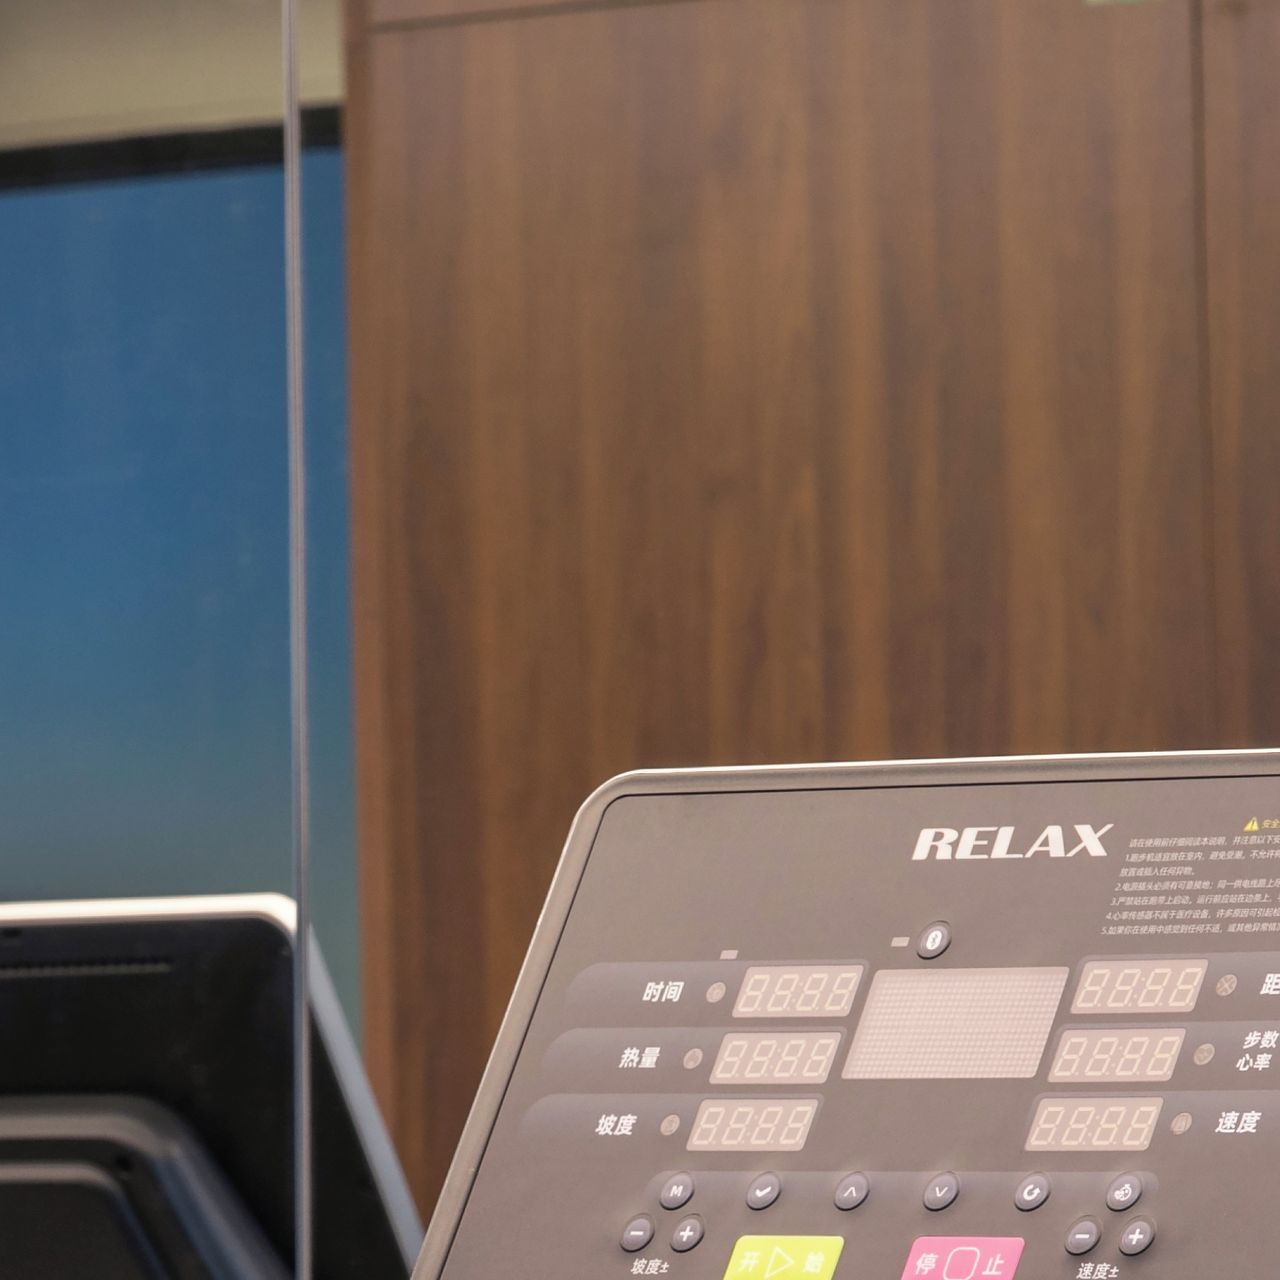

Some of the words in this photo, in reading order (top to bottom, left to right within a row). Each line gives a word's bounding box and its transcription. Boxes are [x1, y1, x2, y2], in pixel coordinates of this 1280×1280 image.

[912, 823, 1114, 861] RELAX
[642, 980, 684, 1003] 时间
[1242, 1030, 1280, 1049] 步数
[618, 1047, 661, 1069] 热量
[1235, 1053, 1273, 1072] 心率
[595, 1114, 637, 1136] 坡度
[1215, 1110, 1261, 1134] 速度
[669, 1185, 684, 1197] M
[915, 1252, 939, 1275] 停
[982, 1253, 1005, 1276] 止
